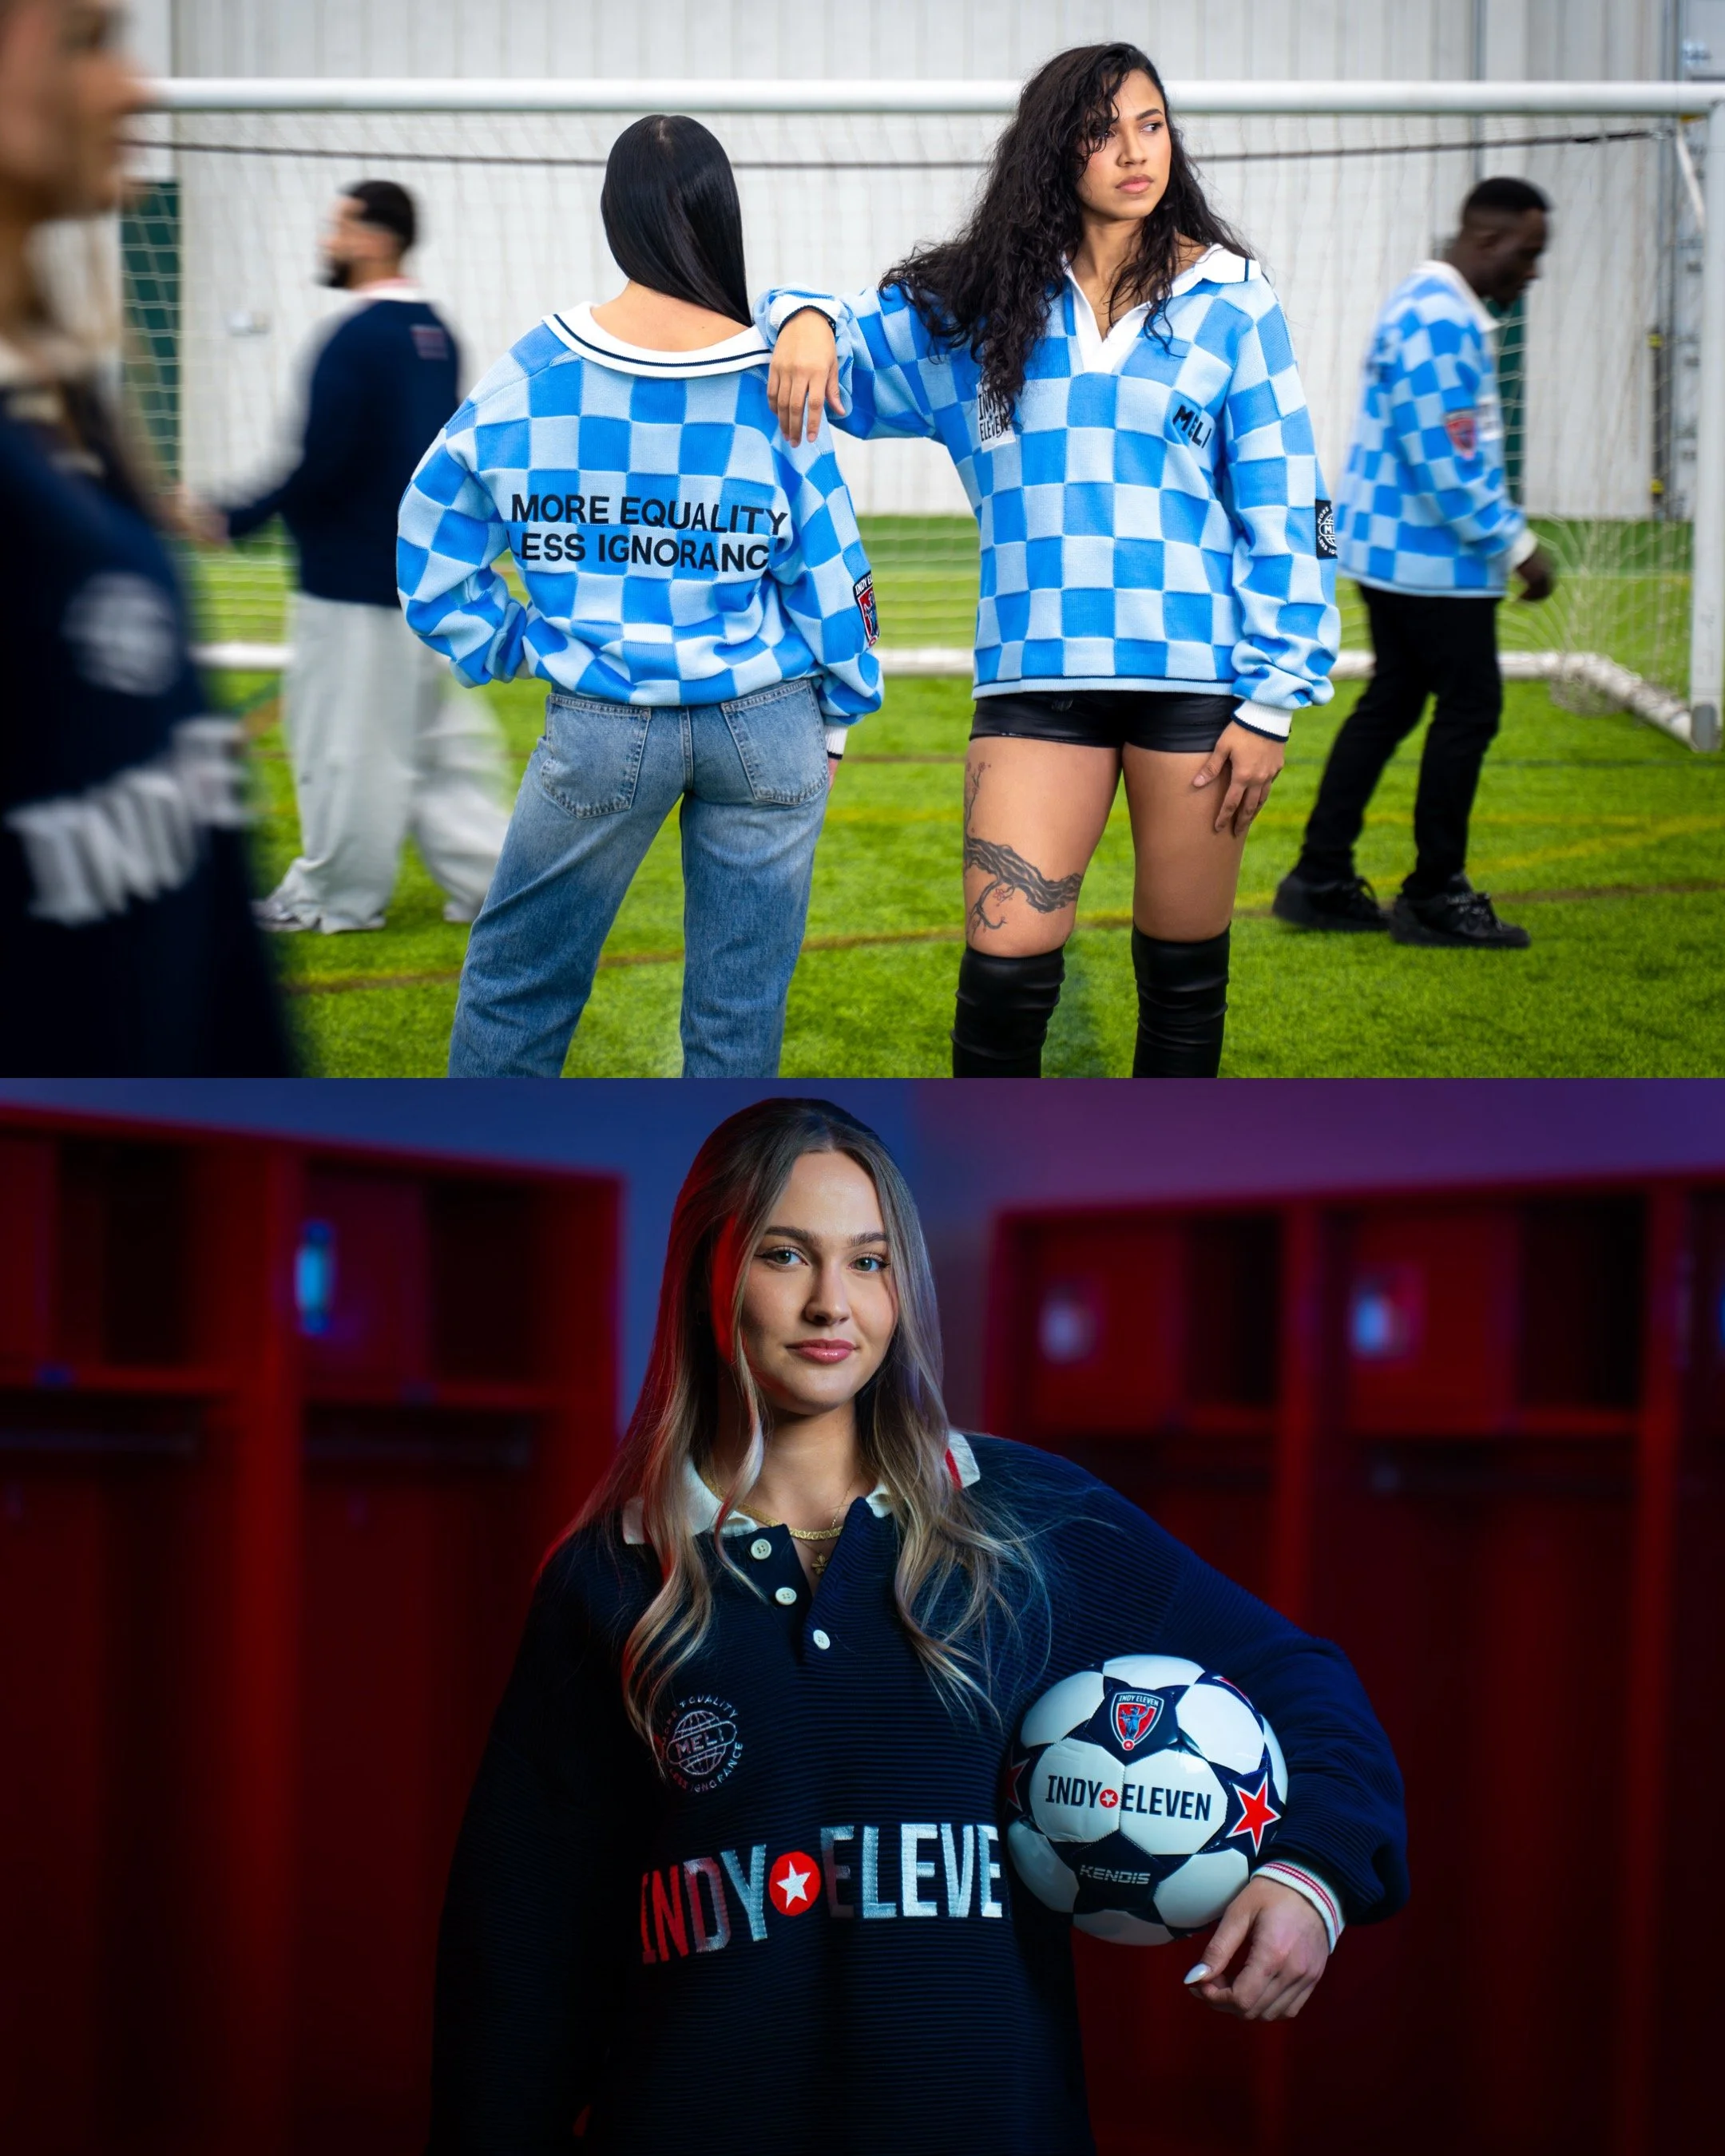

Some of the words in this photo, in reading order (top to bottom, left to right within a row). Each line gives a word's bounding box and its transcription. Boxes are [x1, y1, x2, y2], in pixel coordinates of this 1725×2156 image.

[1172, 404, 1212, 449] MELI
[511, 493, 610, 525] MORE
[620, 497, 788, 536] EQUALITY
[506, 529, 586, 562] LESS
[598, 533, 770, 573] IGNORANC
[1136, 1695, 1160, 1707] ELEVEN
[1045, 1774, 1104, 1809] INDY
[1120, 1784, 1212, 1821] ELEVEN
[640, 1844, 767, 1964] INDY
[820, 1823, 1003, 1919] ELEVE
